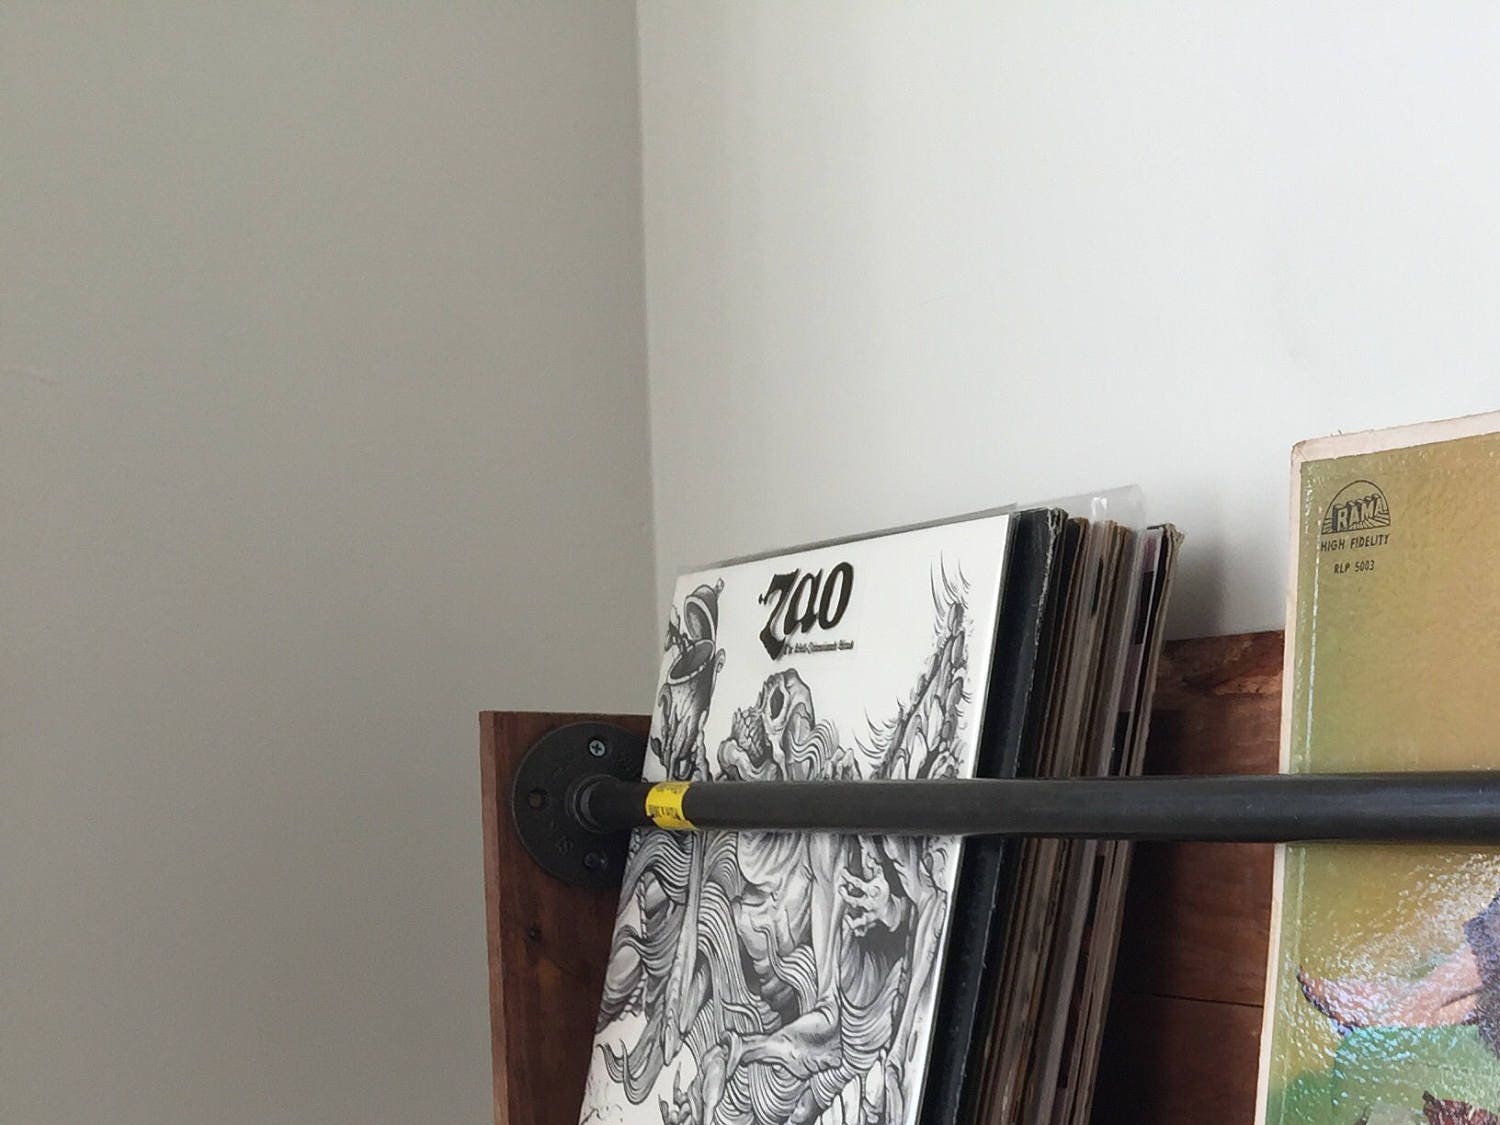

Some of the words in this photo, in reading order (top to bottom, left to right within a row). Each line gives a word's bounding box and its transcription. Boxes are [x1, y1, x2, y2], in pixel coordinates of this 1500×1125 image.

[1332, 494, 1389, 532] RAMA
[1320, 538, 1345, 552] HIGH
[1350, 534, 1389, 549] FIDELITY
[1333, 561, 1350, 575] RLP
[1355, 559, 1375, 573] 5003
